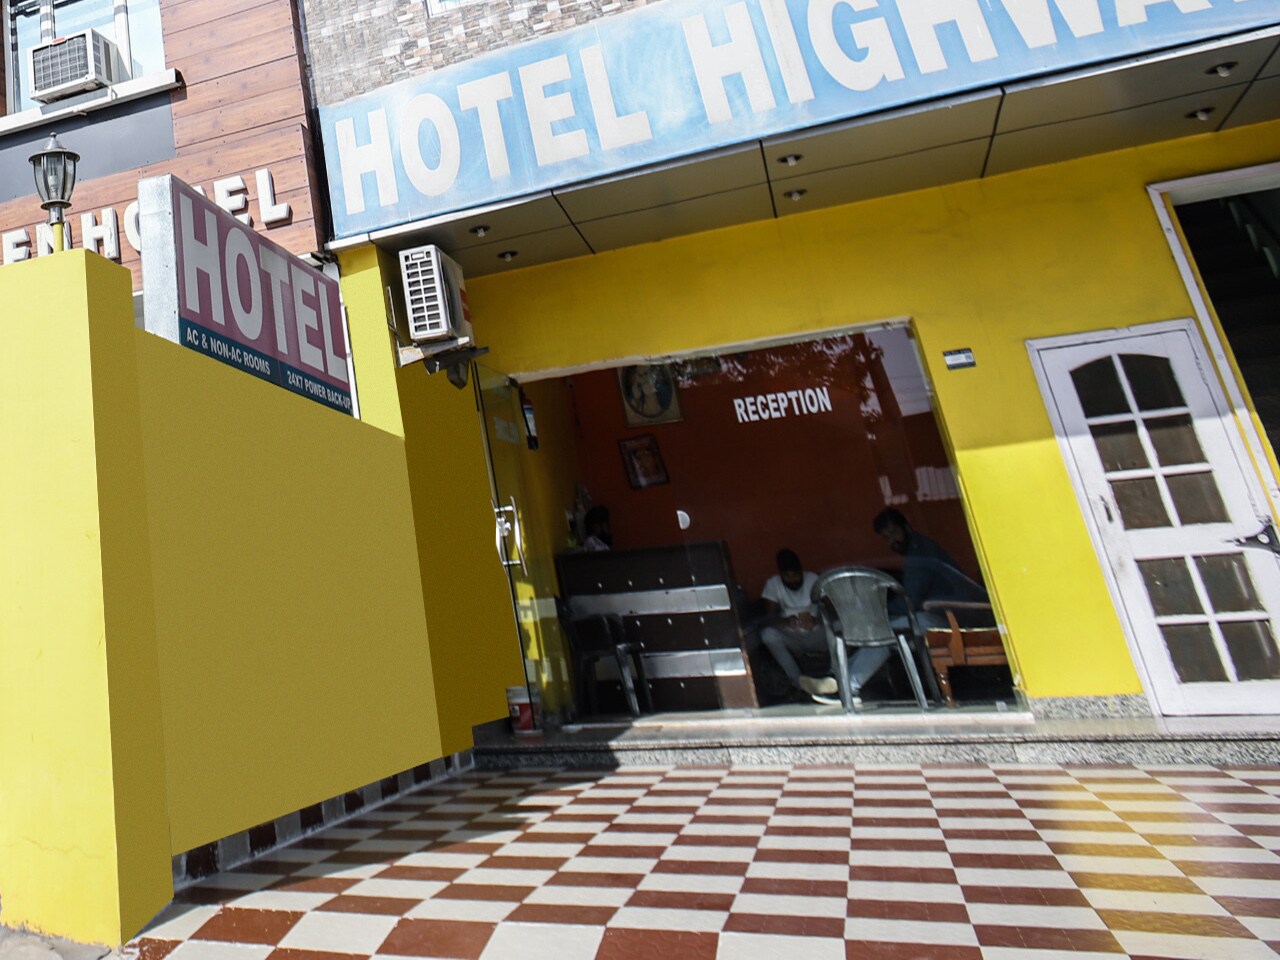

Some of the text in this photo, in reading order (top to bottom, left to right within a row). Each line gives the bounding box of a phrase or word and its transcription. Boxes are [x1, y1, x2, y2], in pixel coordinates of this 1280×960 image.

[334, 43, 652, 214] HOTEL
[179, 191, 348, 383] HOTEL
[186, 327, 271, 376] AC & NON-AC ROOMS
[304, 379, 327, 399] POWER
[327, 388, 351, 410] BACK-UP
[733, 386, 832, 424] RECEPTION
